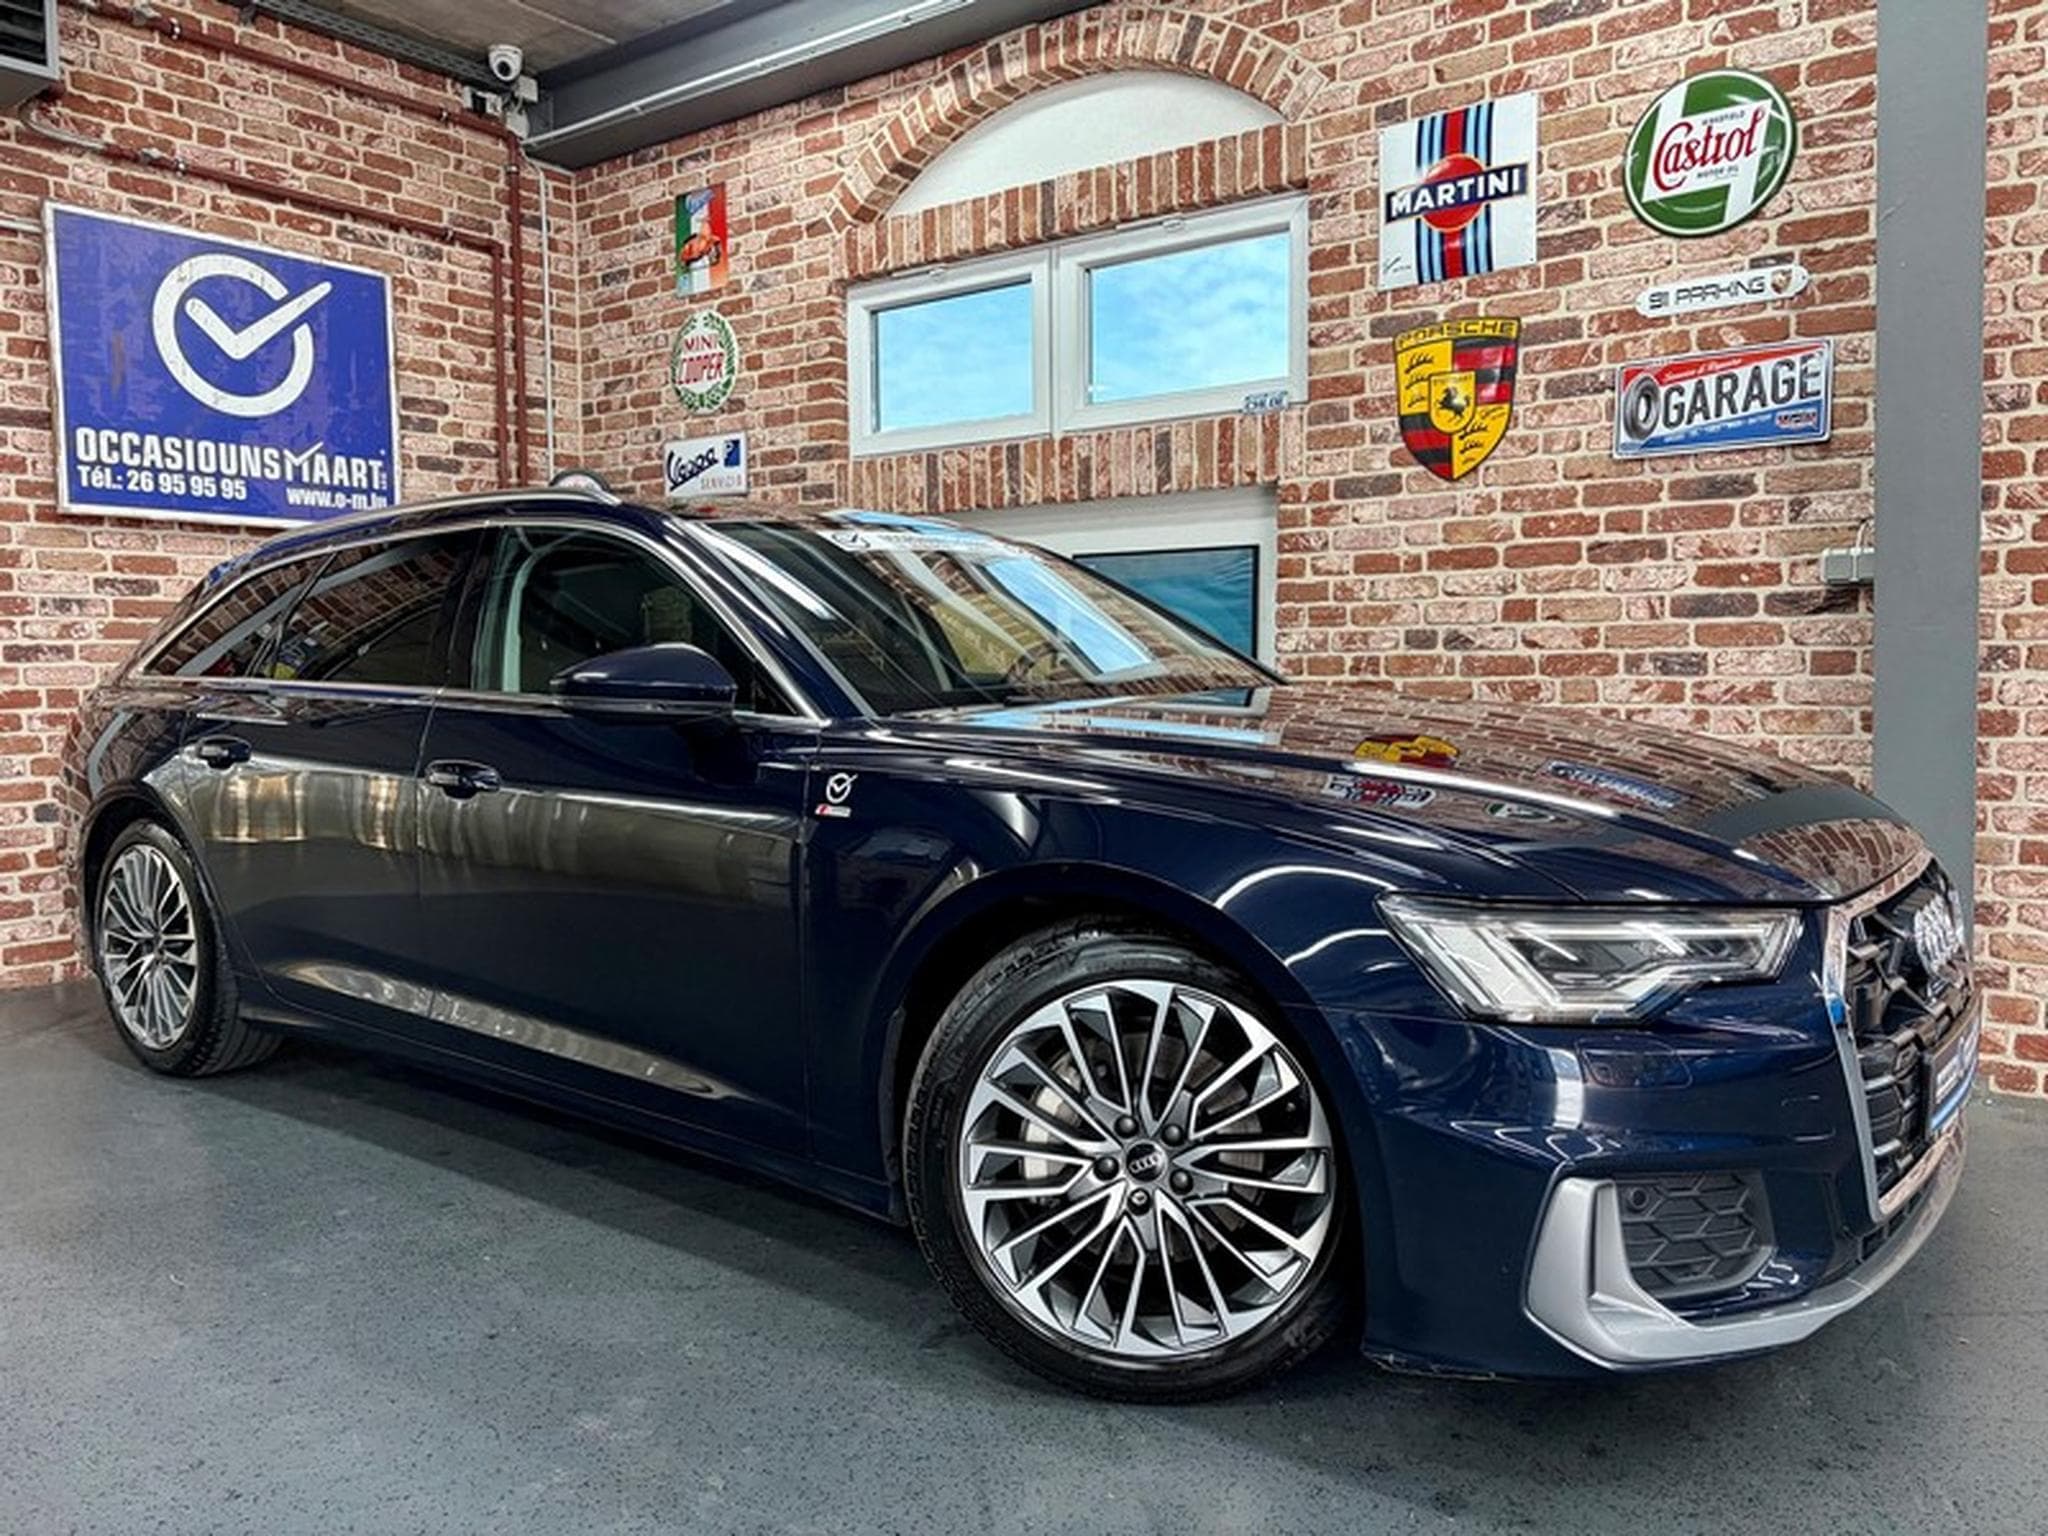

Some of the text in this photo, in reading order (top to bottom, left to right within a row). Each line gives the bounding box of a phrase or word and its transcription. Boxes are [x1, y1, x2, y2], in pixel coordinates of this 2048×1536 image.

[1653, 106, 1766, 192] Castrol
[1390, 168, 1521, 218] MARTINI
[1674, 275, 1766, 305] PARKING
[683, 334, 721, 351] MINI
[1398, 321, 1515, 347] PORSCHE
[1662, 351, 1823, 429] GARAGE
[75, 426, 384, 491] OCCASIOUNSMAART
[667, 449, 720, 492] Vespa
[77, 465, 247, 501] Tél.: 26 95 95 95
